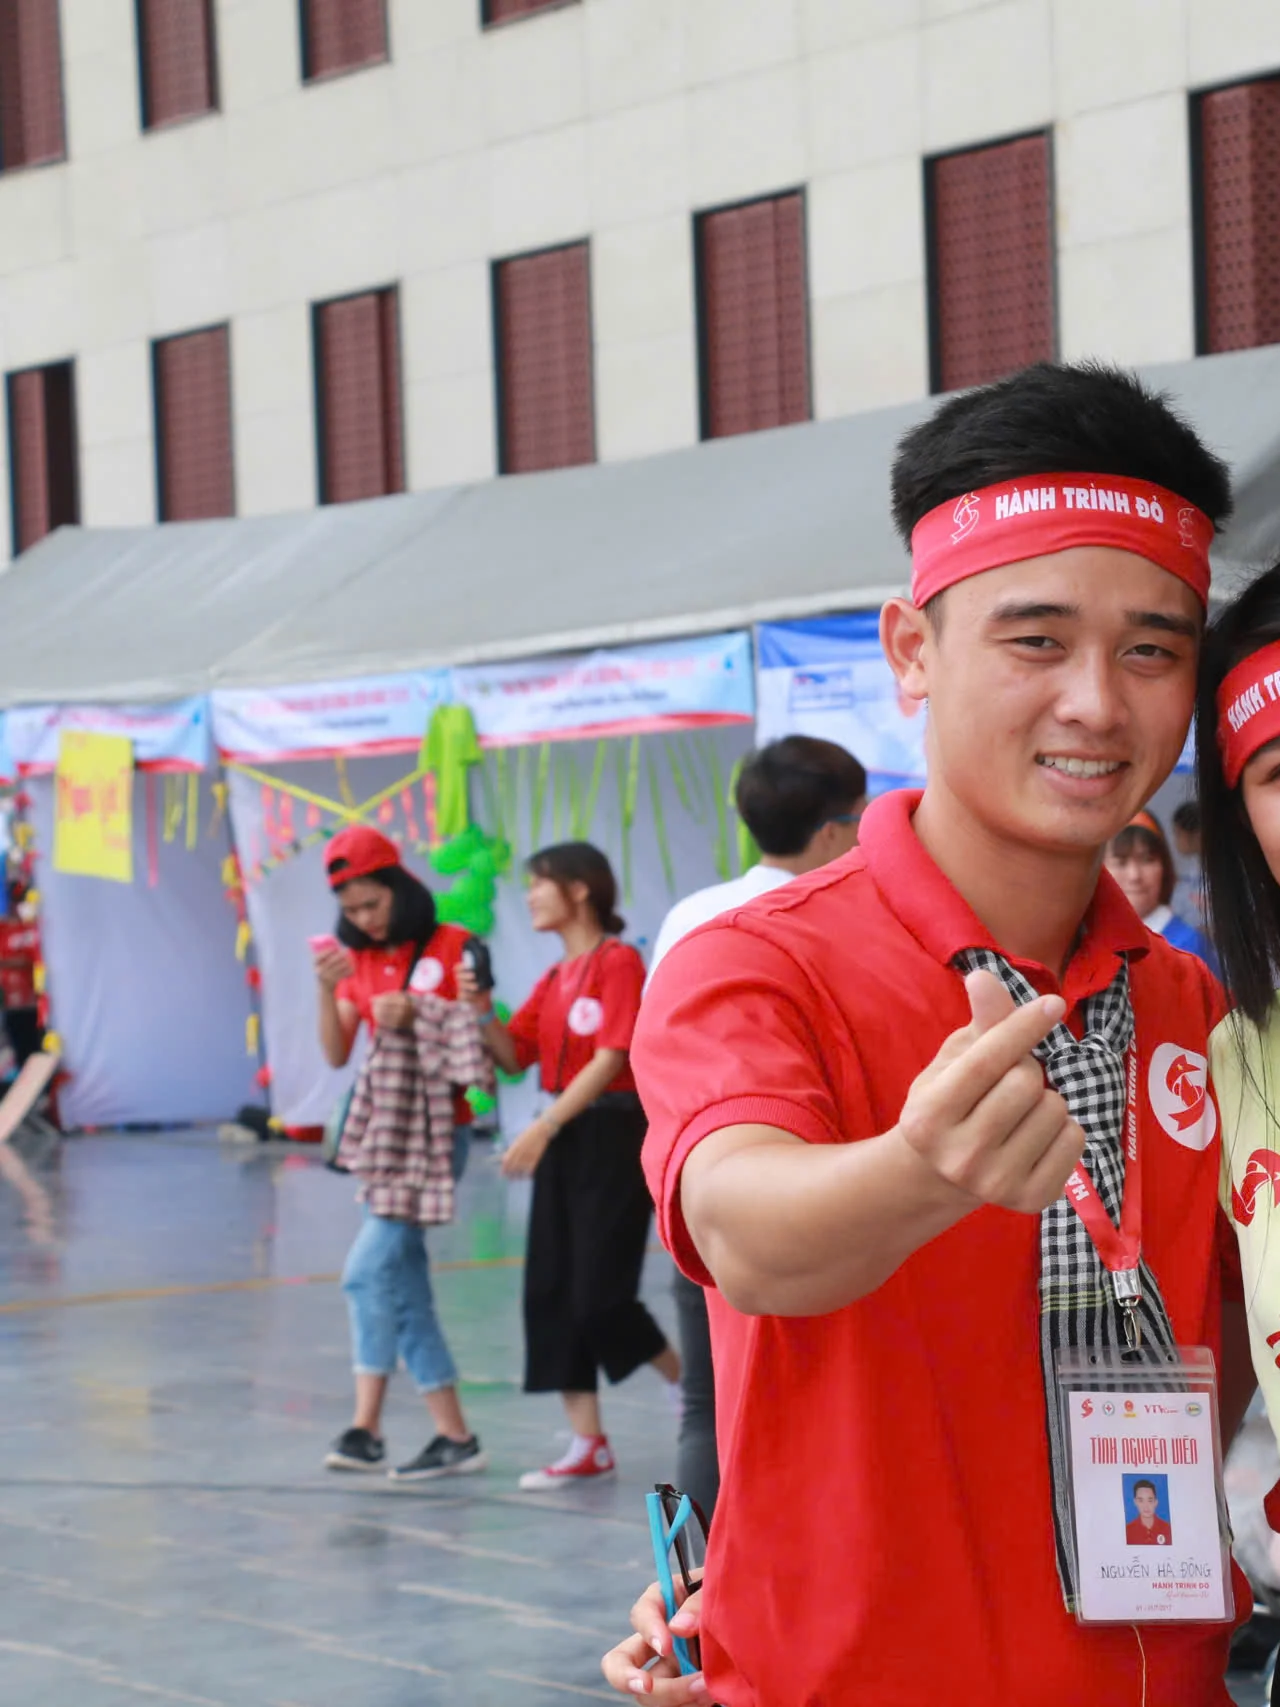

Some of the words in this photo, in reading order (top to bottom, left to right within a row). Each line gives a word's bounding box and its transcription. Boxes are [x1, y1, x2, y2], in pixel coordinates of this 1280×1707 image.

[995, 486, 1056, 521] HÀNH
[1063, 482, 1131, 515] TRÌNH
[1135, 494, 1164, 524] ĐỎ
[1227, 682, 1266, 733] HÀNH
[1090, 1434, 1118, 1464] TÌNH
[1101, 1555, 1150, 1578] NGUYỄN
